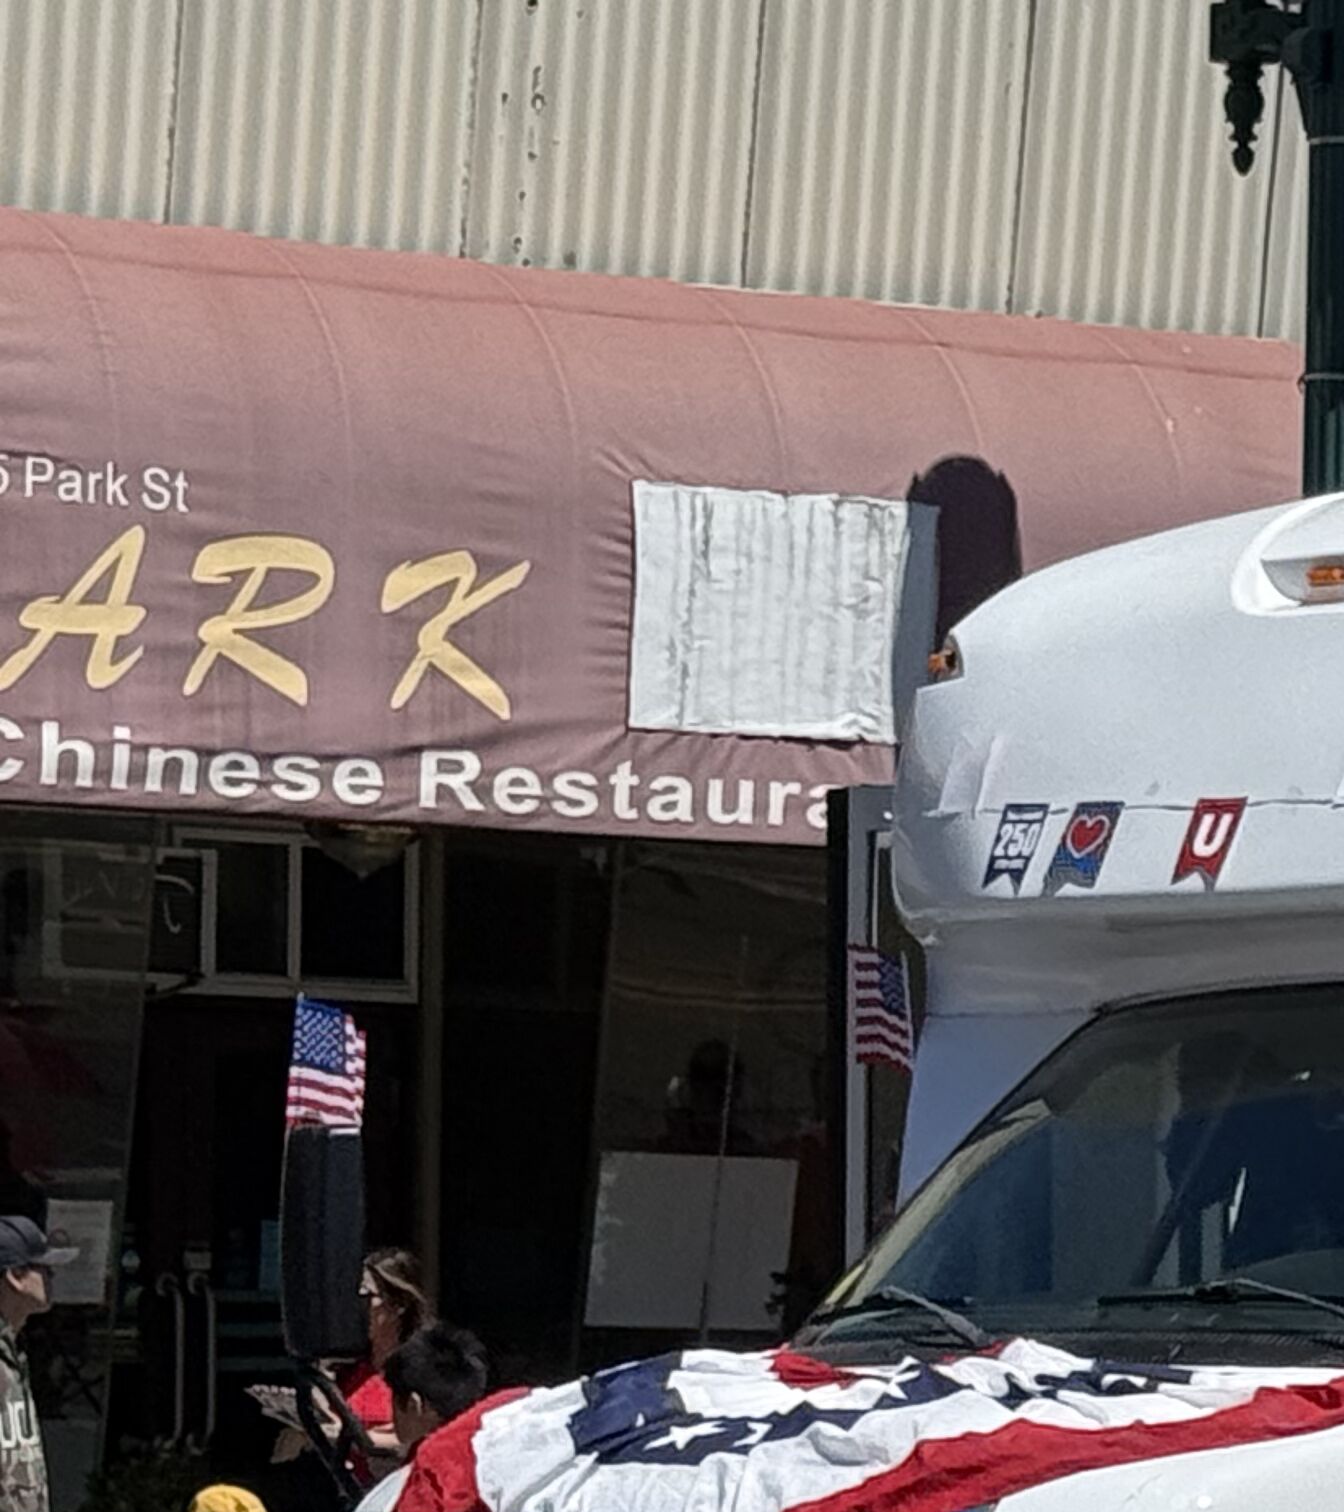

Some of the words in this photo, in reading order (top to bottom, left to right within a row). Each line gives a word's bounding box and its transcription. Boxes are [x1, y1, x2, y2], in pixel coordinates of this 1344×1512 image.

[24, 456, 129, 507] Park
[141, 467, 190, 513] St
[993, 822, 1041, 857] 250
[1192, 812, 1235, 858] U
